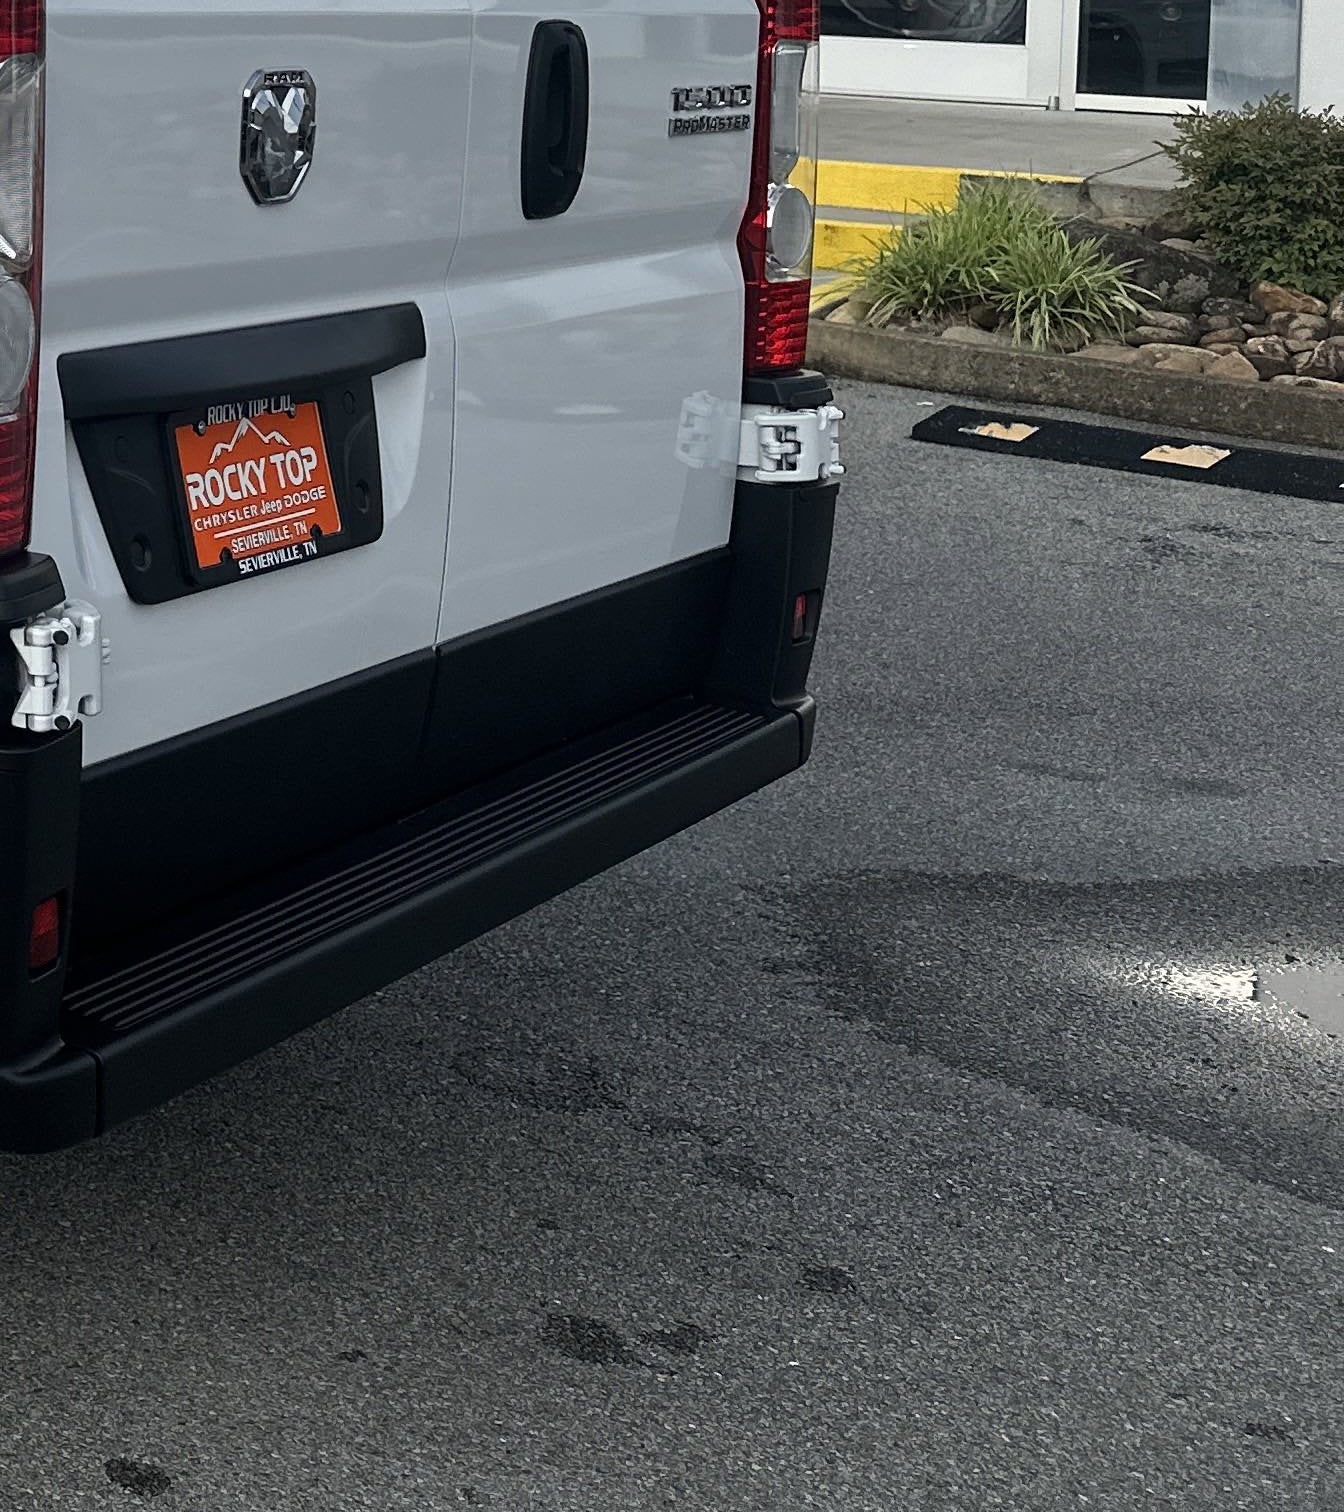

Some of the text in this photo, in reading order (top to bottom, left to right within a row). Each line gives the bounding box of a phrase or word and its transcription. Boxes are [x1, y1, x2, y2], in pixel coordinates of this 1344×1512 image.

[207, 401, 245, 426] ROCKY
[247, 397, 269, 419] TOP
[185, 446, 318, 511] ROCKY TOP
[194, 485, 327, 532] CHRYSLER Jeep DODGE
[293, 520, 309, 536] TN
[238, 541, 318, 575] SEVIERVILLE, TN
